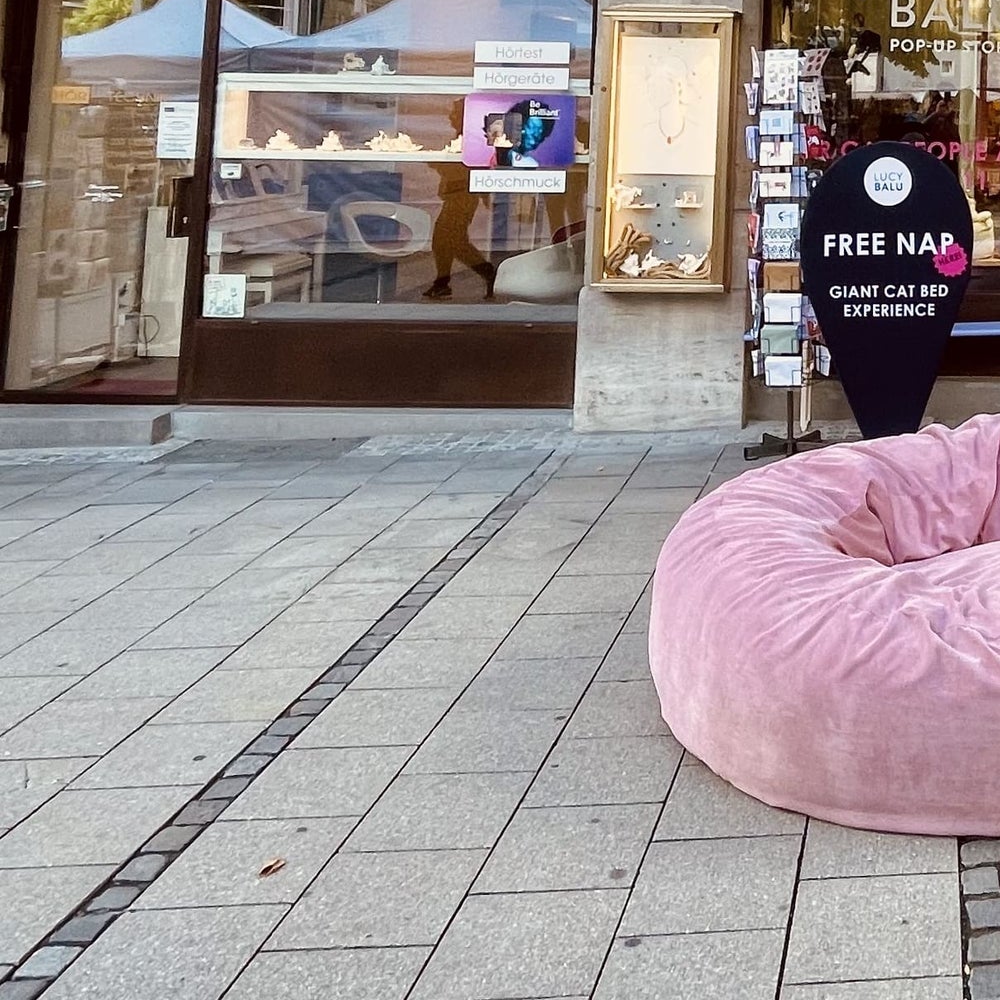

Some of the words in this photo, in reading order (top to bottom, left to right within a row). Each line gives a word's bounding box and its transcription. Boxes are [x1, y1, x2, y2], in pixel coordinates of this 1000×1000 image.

[889, 38, 957, 52] POP-UP
[495, 46, 543, 59] Hörtest
[484, 72, 556, 87] Hörgeräte
[529, 99, 541, 109] Be
[474, 175, 561, 189] Hörschmuck
[874, 172, 903, 182] LUCY
[874, 182, 903, 192] BALU
[823, 232, 886, 257] FREE
[896, 231, 955, 256] NAP
[829, 285, 879, 299] GIANT
[884, 284, 916, 298] CAT
[920, 284, 949, 298] BED
[843, 303, 936, 318] EXPERIENCE
